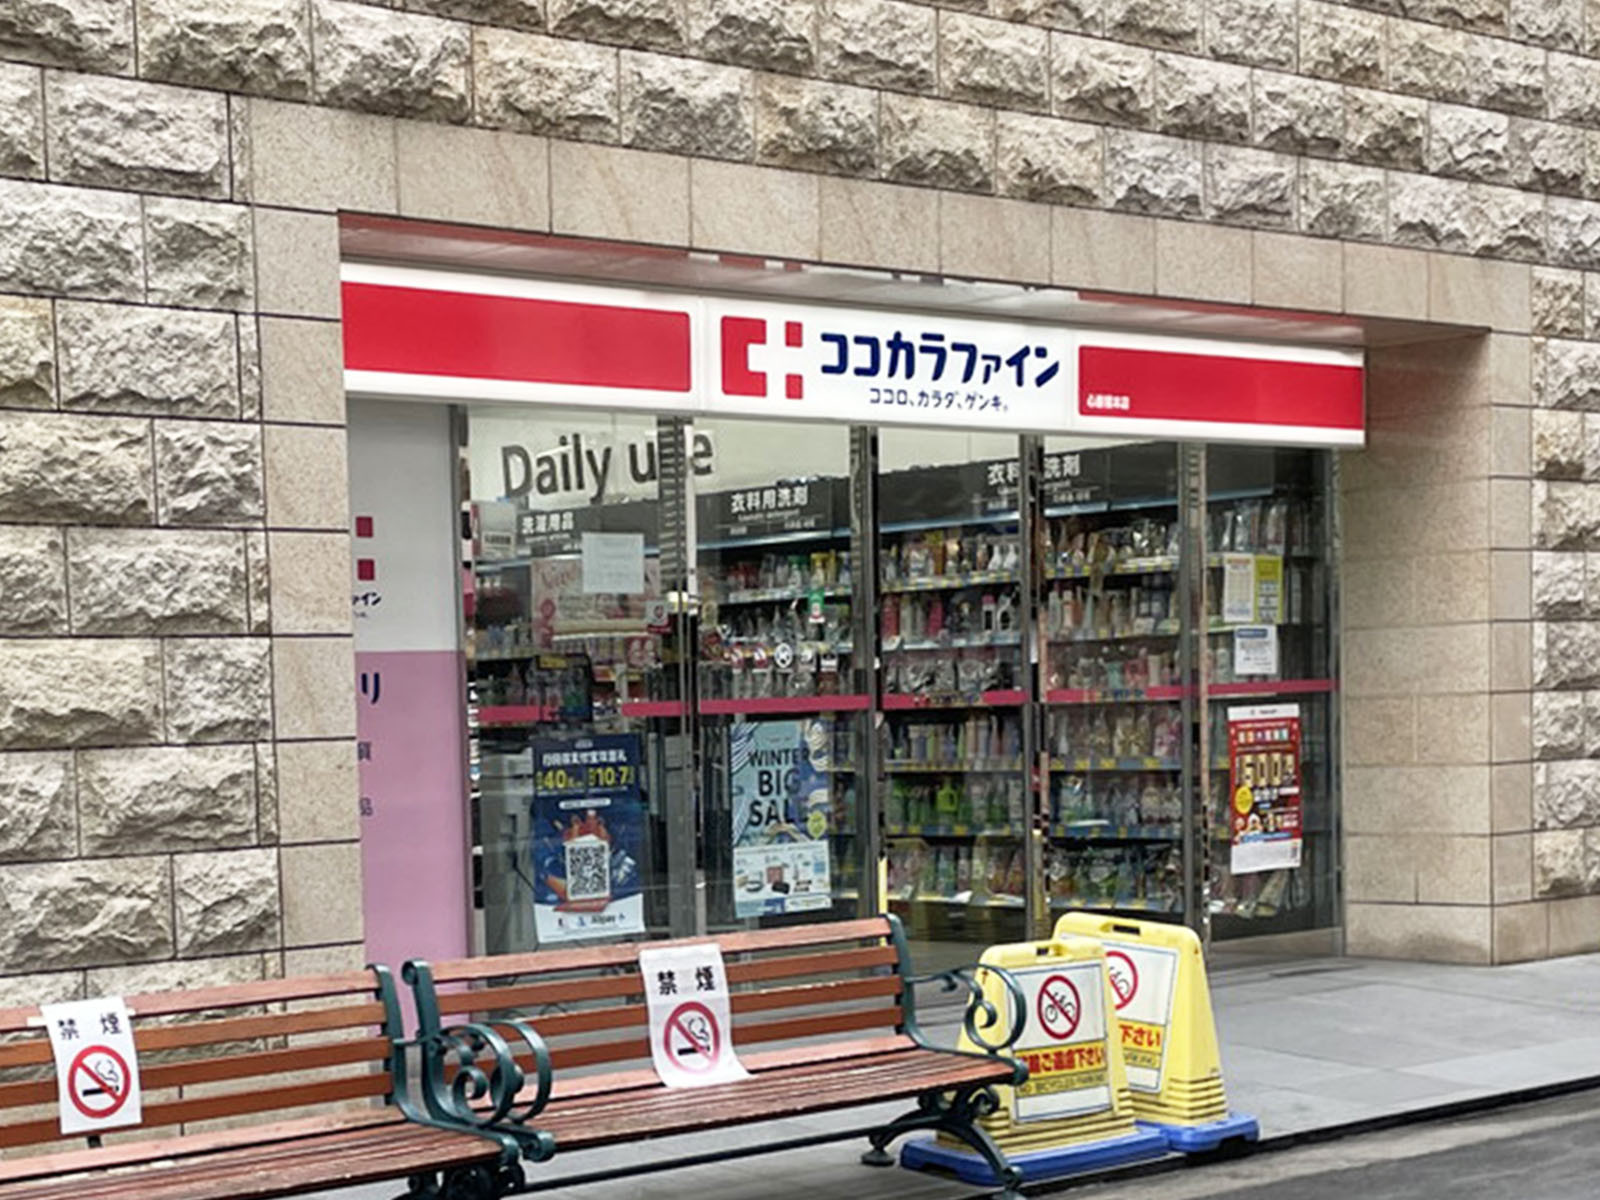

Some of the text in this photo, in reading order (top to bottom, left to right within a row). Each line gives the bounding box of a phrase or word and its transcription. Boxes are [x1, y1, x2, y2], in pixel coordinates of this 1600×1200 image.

[820, 331, 1060, 388] ココカラファイン
[502, 432, 714, 504] Daily ue
[987, 453, 1080, 485] 衣料洗剤
[731, 485, 808, 513] 衣料用洗剤
[758, 768, 801, 796] BIG
[657, 964, 716, 996] 禁煙
[57, 1011, 123, 1041] 禁煙
[1118, 1024, 1161, 1047] 下さい
